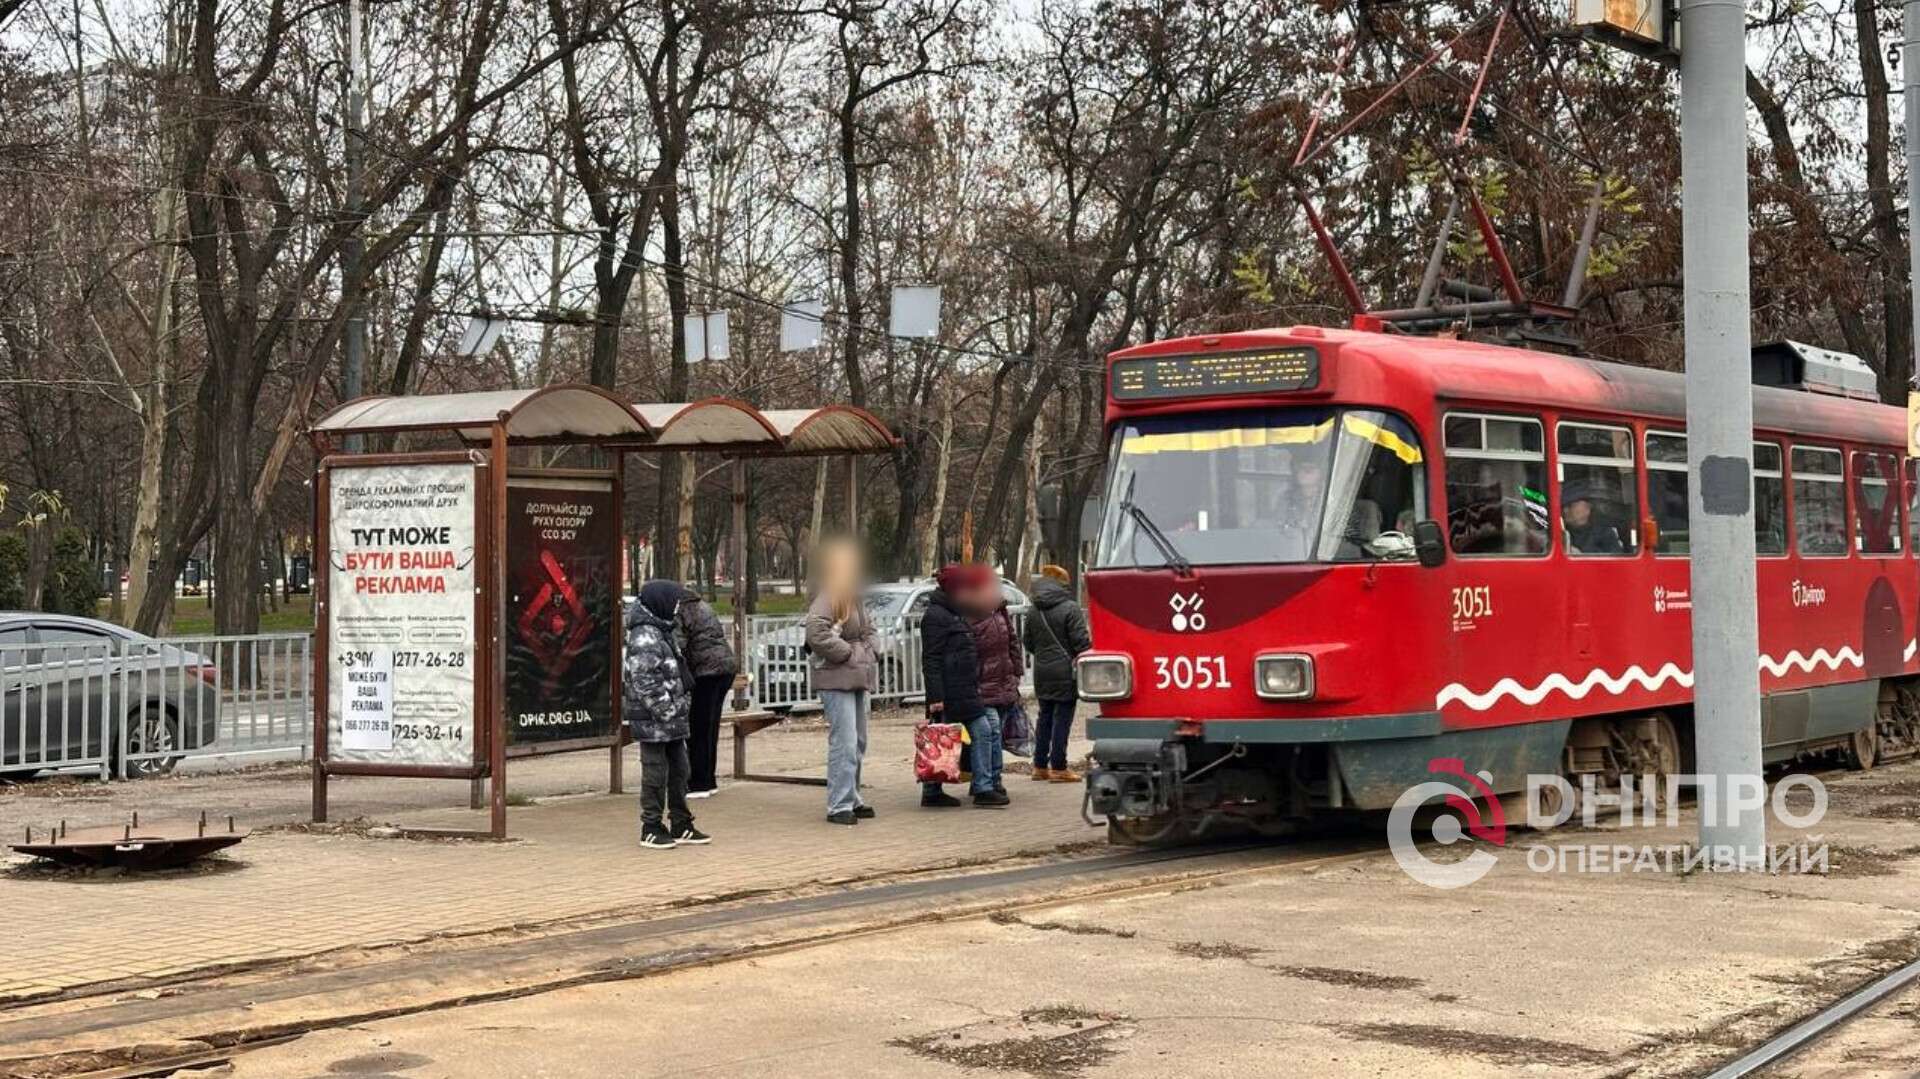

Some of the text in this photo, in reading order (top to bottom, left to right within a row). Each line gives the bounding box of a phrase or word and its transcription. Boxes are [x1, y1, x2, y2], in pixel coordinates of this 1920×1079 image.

[351, 527, 451, 546] ТУТ МОЖЕ
[541, 529, 577, 540] ССО ЗСУ
[346, 551, 455, 571] БУТИ ВАША
[355, 575, 446, 595] РЕКЛАМА
[1450, 585, 1493, 619] 3051
[348, 671, 387, 682] МОЖЕ БУТИ
[1153, 655, 1232, 690] 3051
[358, 686, 378, 697] ВАША
[351, 700, 383, 711] РЕКЛАМА
